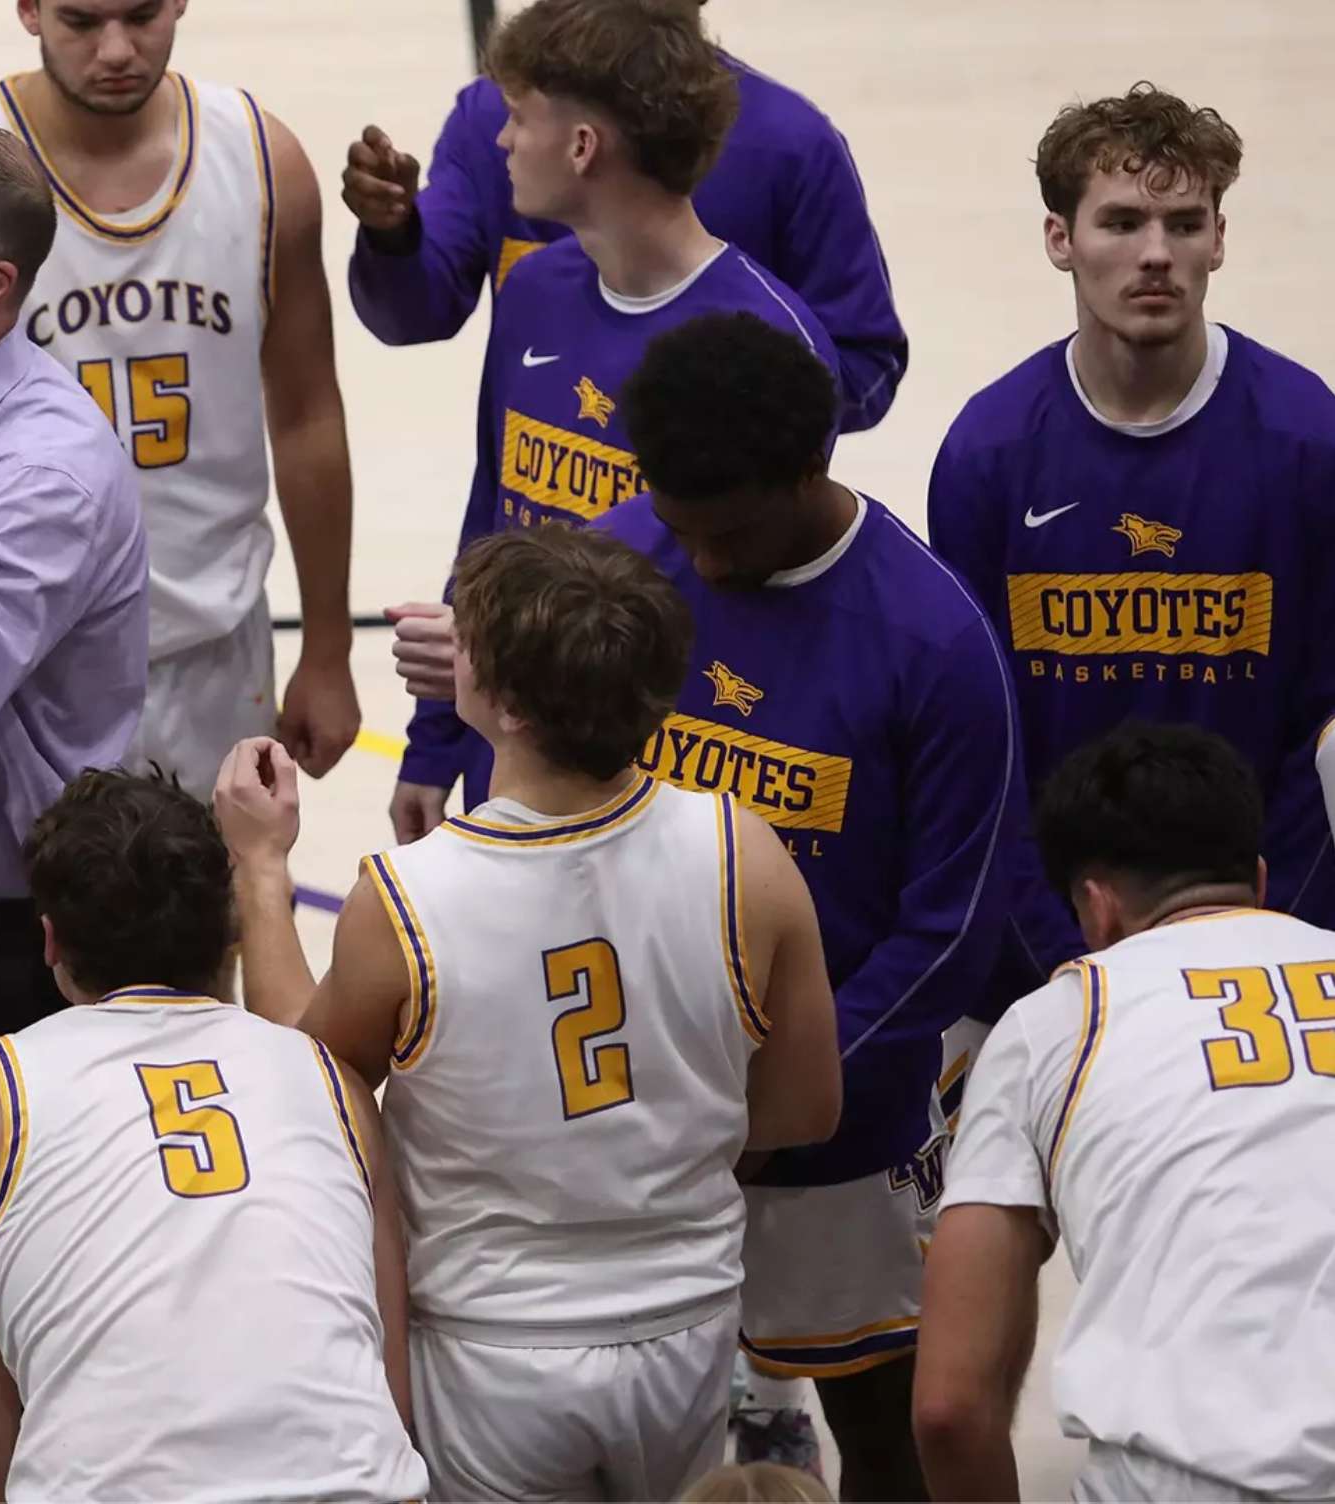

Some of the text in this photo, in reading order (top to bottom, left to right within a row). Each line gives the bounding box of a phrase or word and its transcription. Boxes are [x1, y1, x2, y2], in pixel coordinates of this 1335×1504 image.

[26, 279, 232, 347] COYOTES
[1040, 586, 1247, 639] COYOTES
[1030, 660, 1255, 685] BASKETBALL
[541, 936, 635, 1121] 2
[133, 1059, 251, 1199] 5
